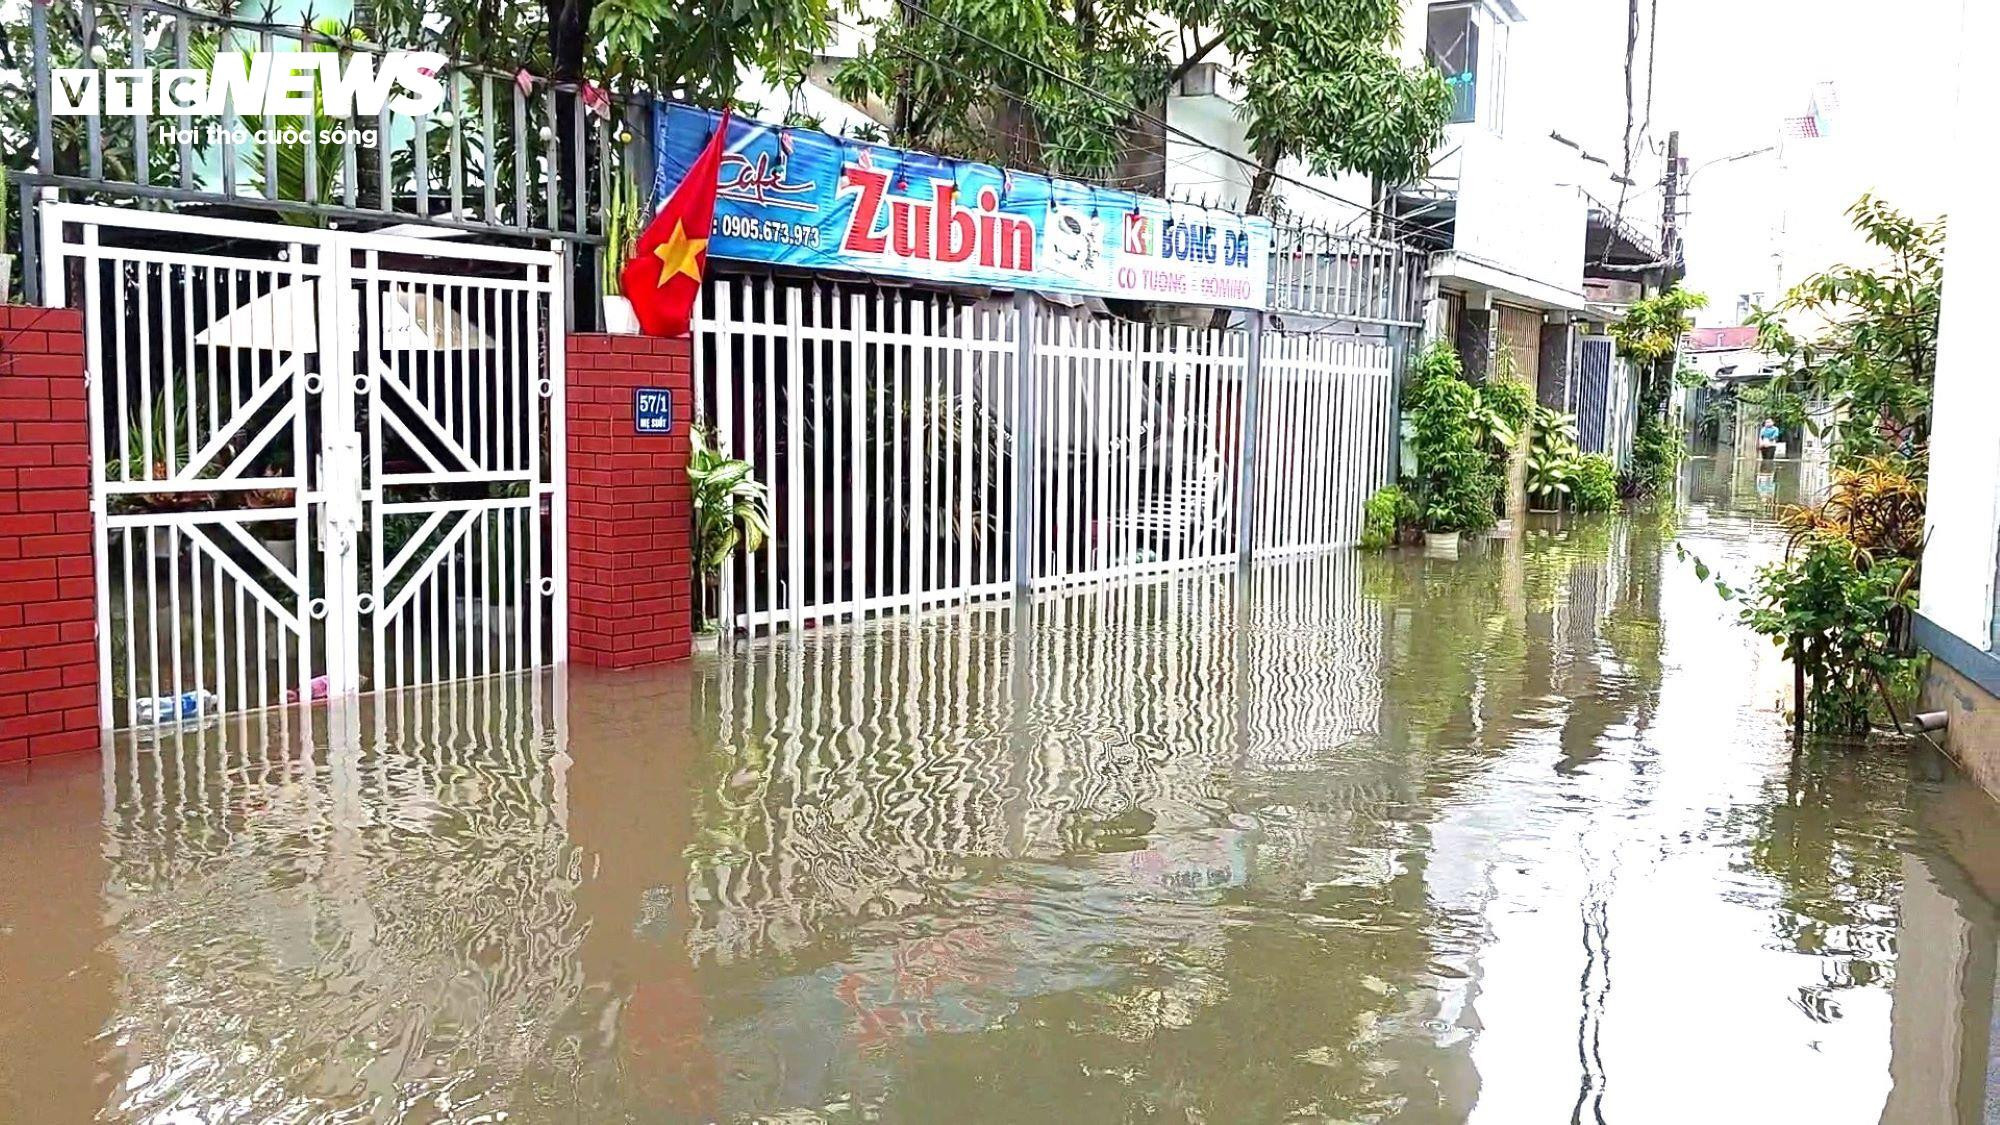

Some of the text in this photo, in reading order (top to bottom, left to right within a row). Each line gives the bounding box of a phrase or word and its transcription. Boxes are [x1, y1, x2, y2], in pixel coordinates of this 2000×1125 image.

[722, 214, 820, 248] 0905.673.973
[843, 167, 1033, 272] Zubin
[640, 393, 667, 414] 57/1
